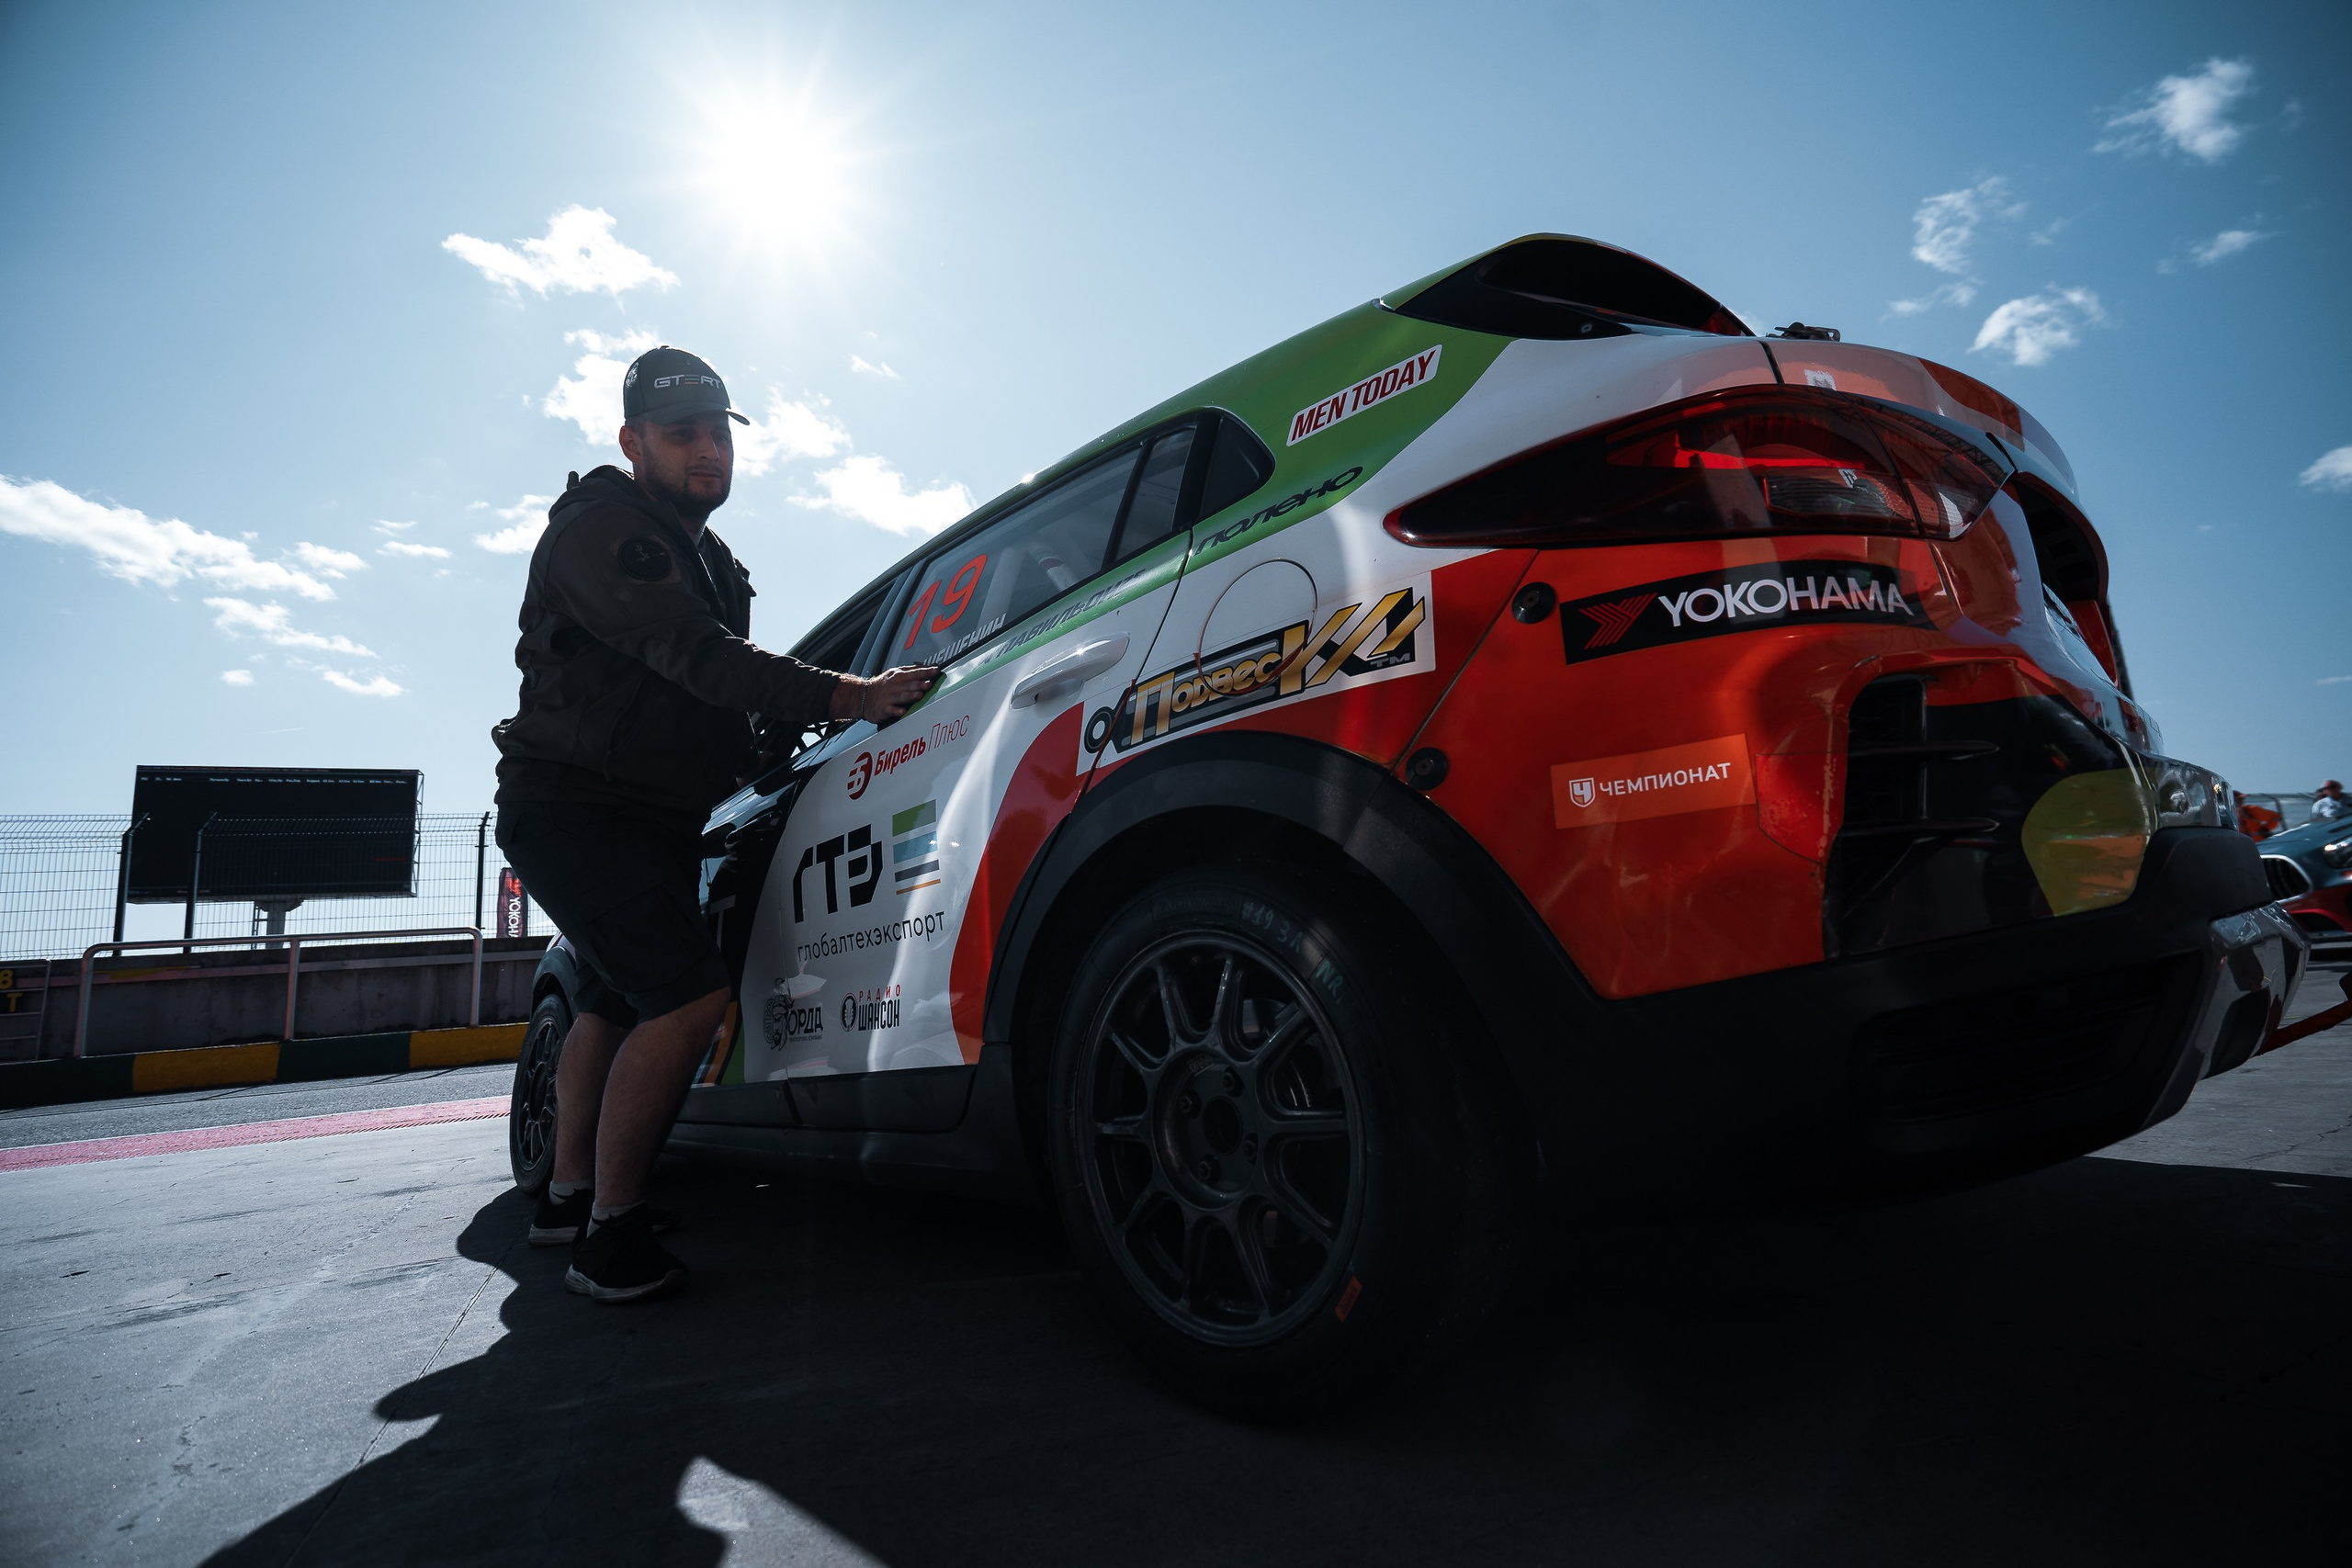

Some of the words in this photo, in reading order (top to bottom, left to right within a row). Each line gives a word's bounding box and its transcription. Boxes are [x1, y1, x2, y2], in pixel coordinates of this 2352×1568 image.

[1290, 390, 1348, 442] MEN
[1351, 349, 1436, 413] TODAY
[904, 553, 988, 650] 19
[1657, 576, 1915, 627] YOKOHAMA
[874, 735, 926, 776] Бирель
[928, 715, 970, 752] Плюс
[1600, 762, 1731, 797] ЧЕМПИОНАТ
[797, 910, 945, 962] глобалтехэкспорт
[858, 998, 900, 1032] ШАНСОН
[859, 984, 901, 1003] РАДИО
[787, 1007, 823, 1036] ОРДА
